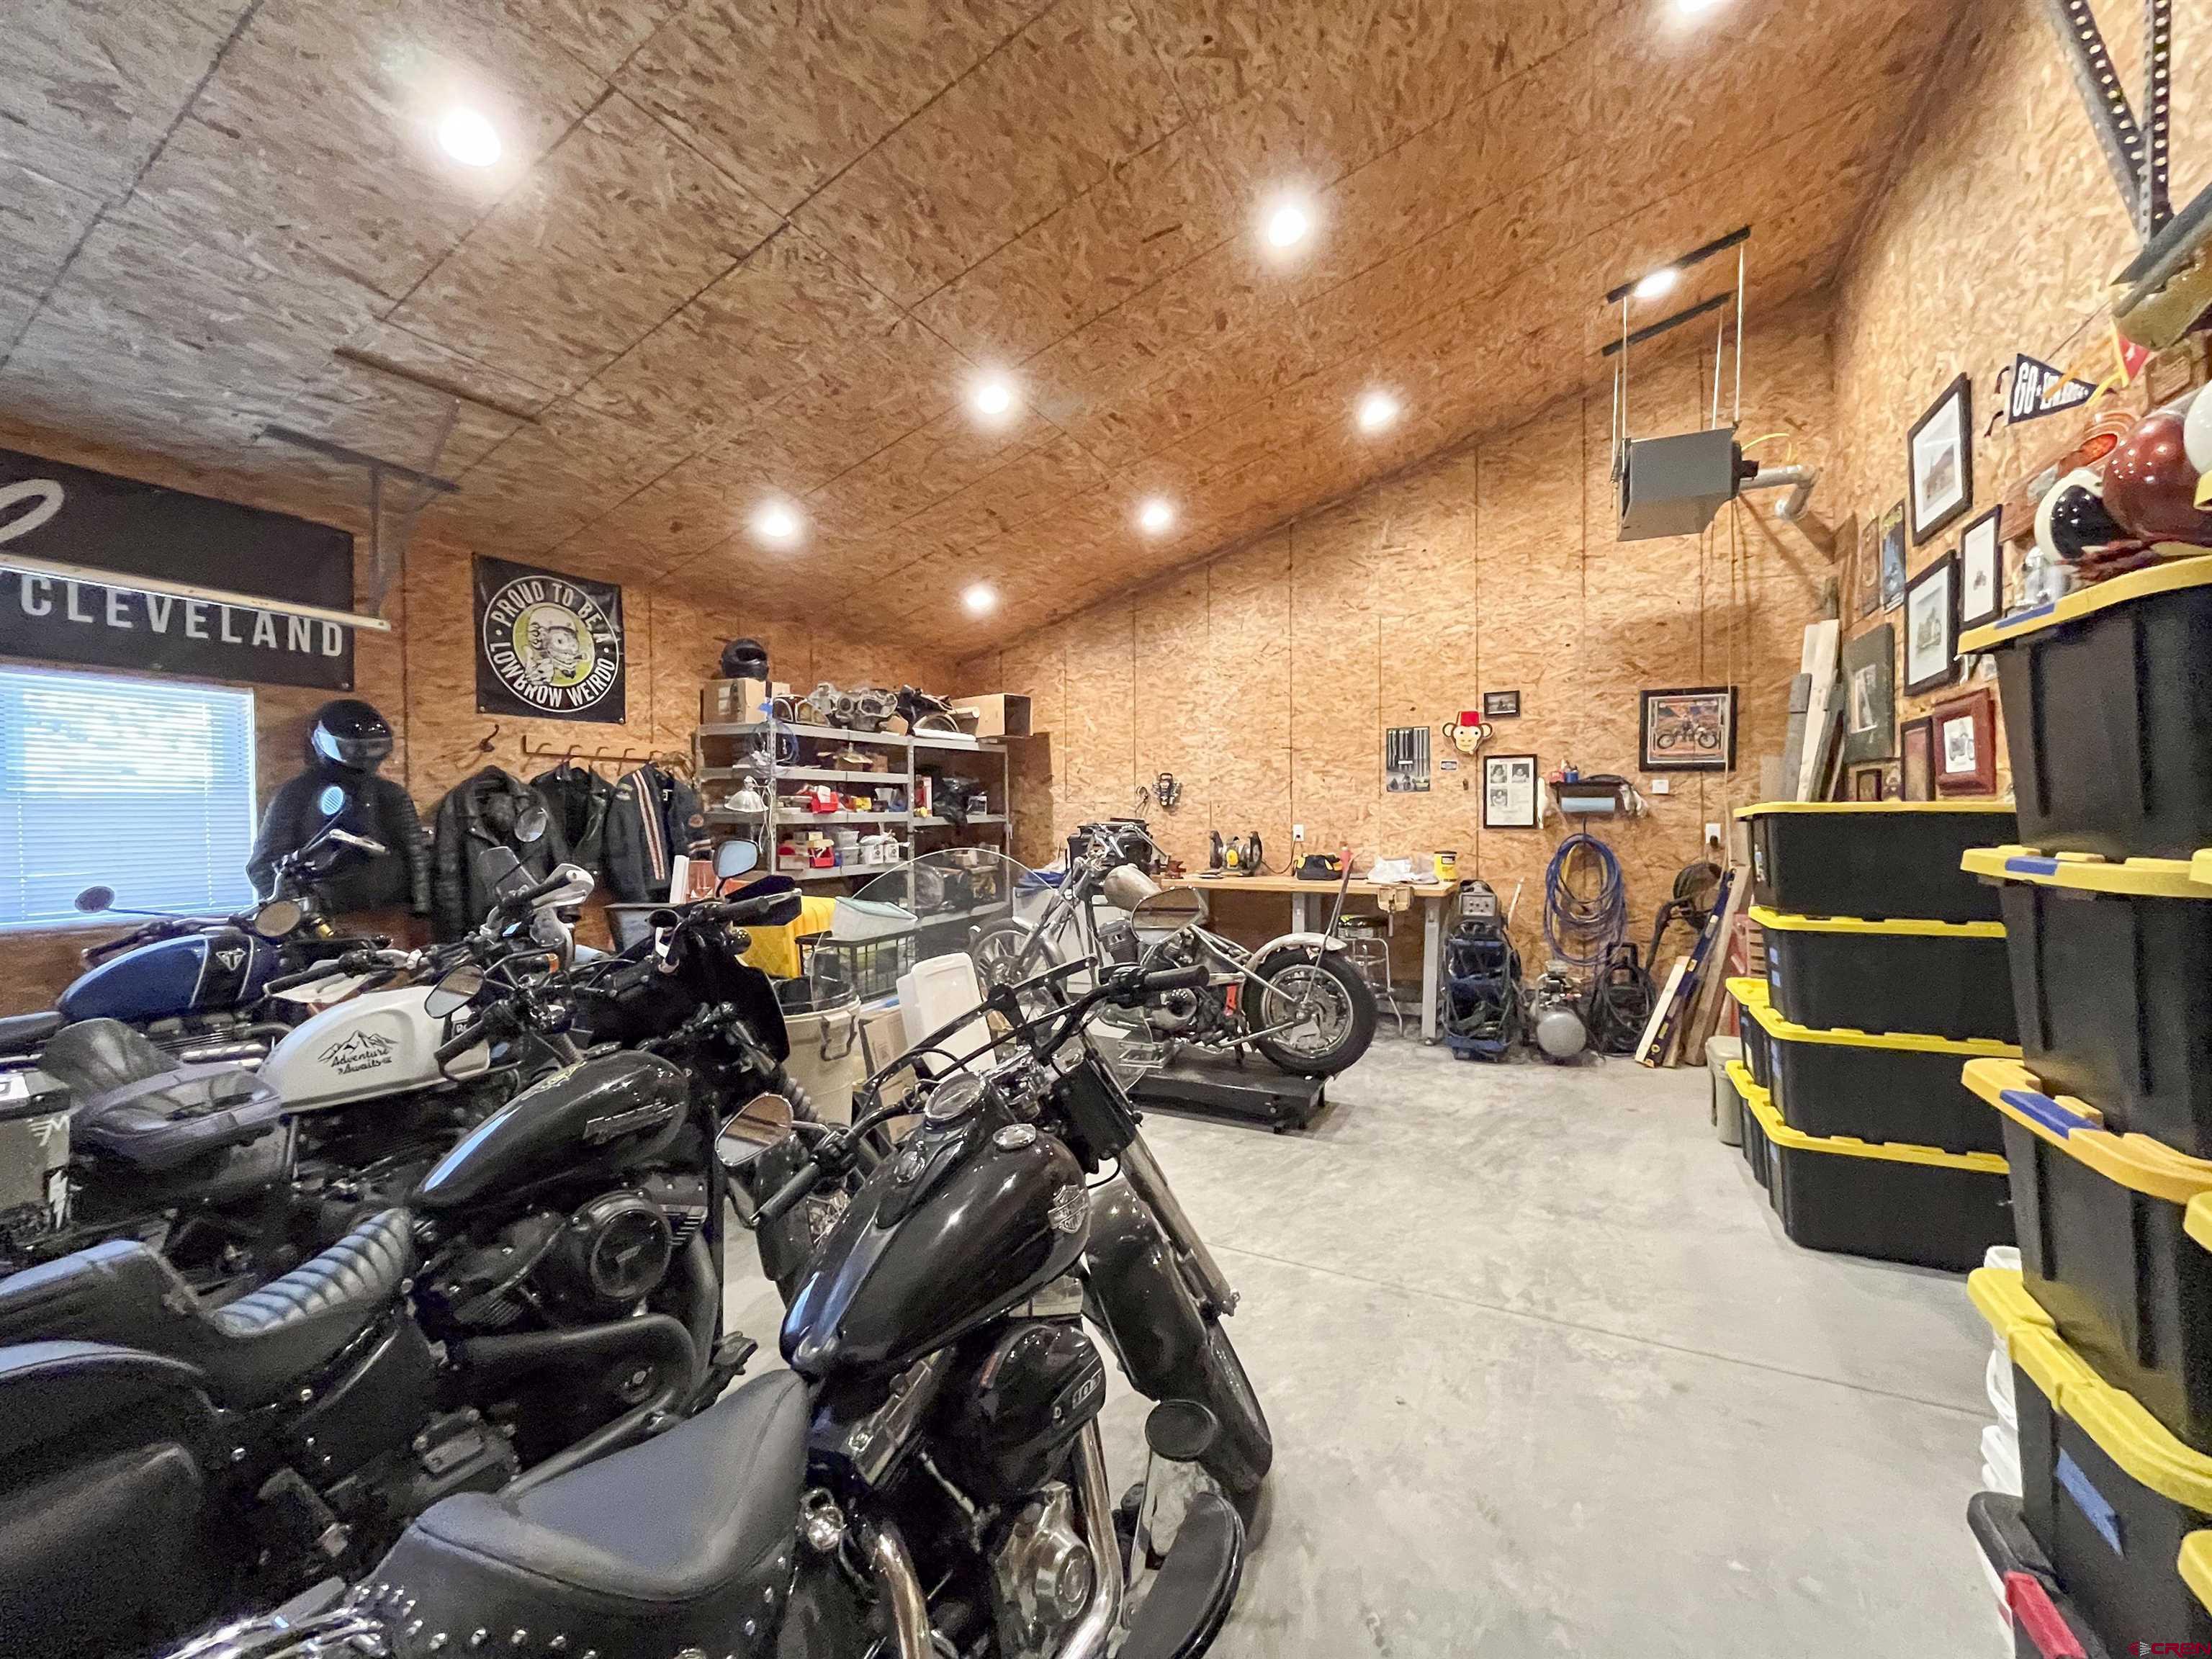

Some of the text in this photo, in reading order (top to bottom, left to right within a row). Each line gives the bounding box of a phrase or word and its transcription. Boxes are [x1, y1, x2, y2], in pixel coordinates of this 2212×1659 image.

[20, 574, 343, 657] CLEVELAND
[490, 581, 613, 644] PROUD TO BE A
[490, 642, 616, 708] LOWBROW WEIRDO
[331, 1048, 391, 1068] Adventure
[341, 1059, 381, 1074] Awaits
